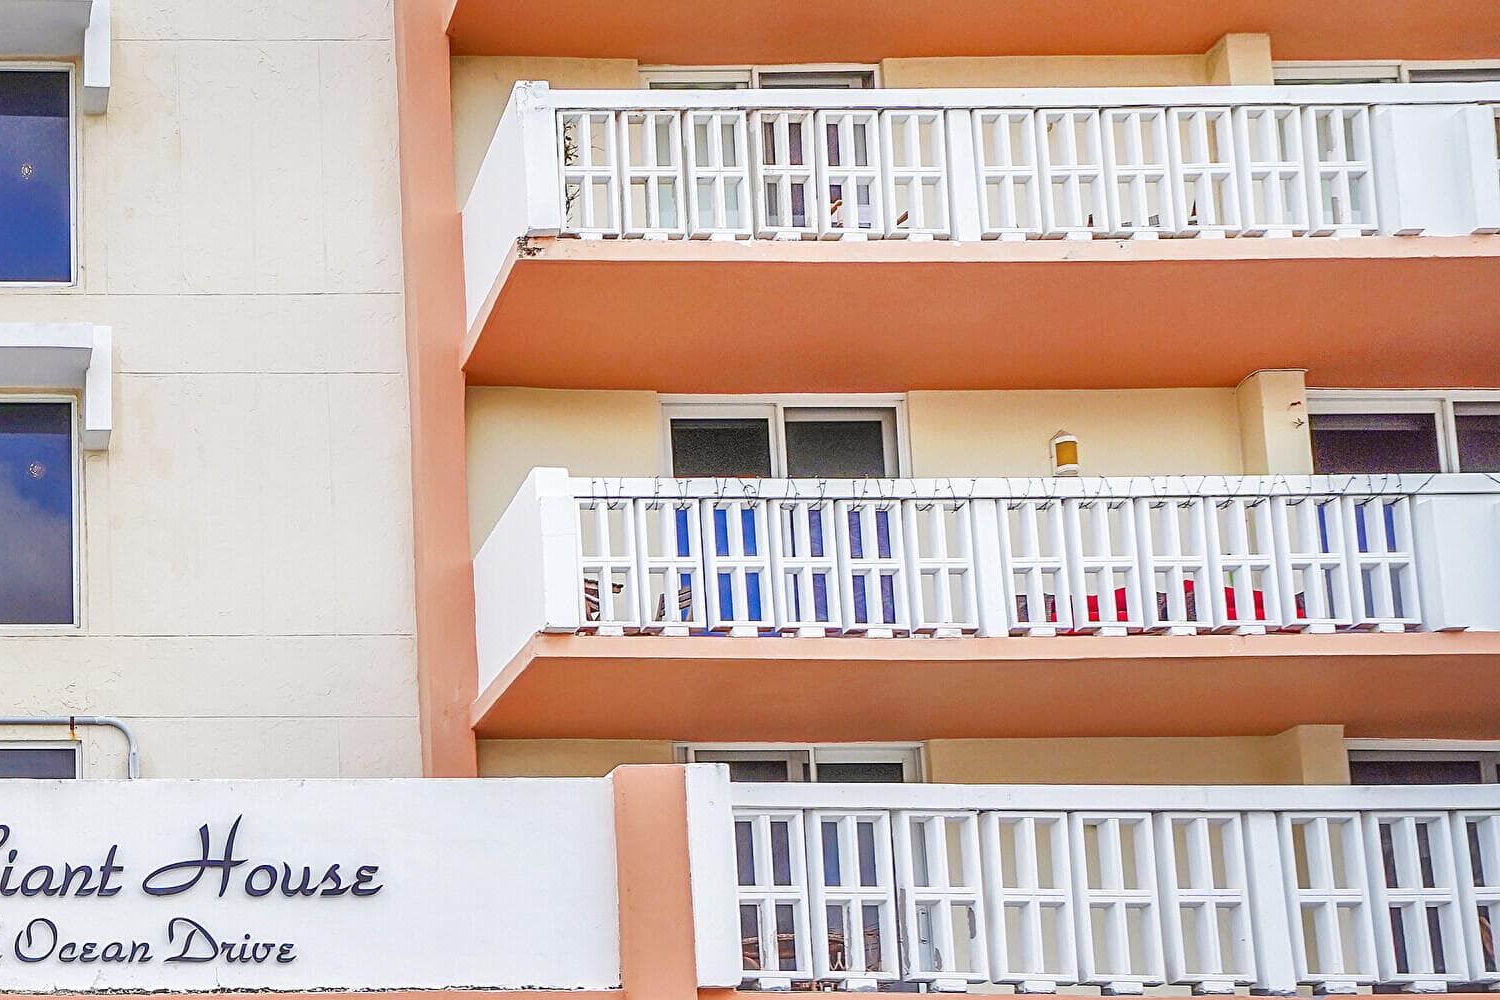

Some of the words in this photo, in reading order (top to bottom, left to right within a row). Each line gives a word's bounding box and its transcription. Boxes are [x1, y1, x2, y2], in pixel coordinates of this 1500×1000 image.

[142, 813, 383, 898] House
[14, 918, 152, 964] Ocean
[164, 916, 296, 964] Drive
